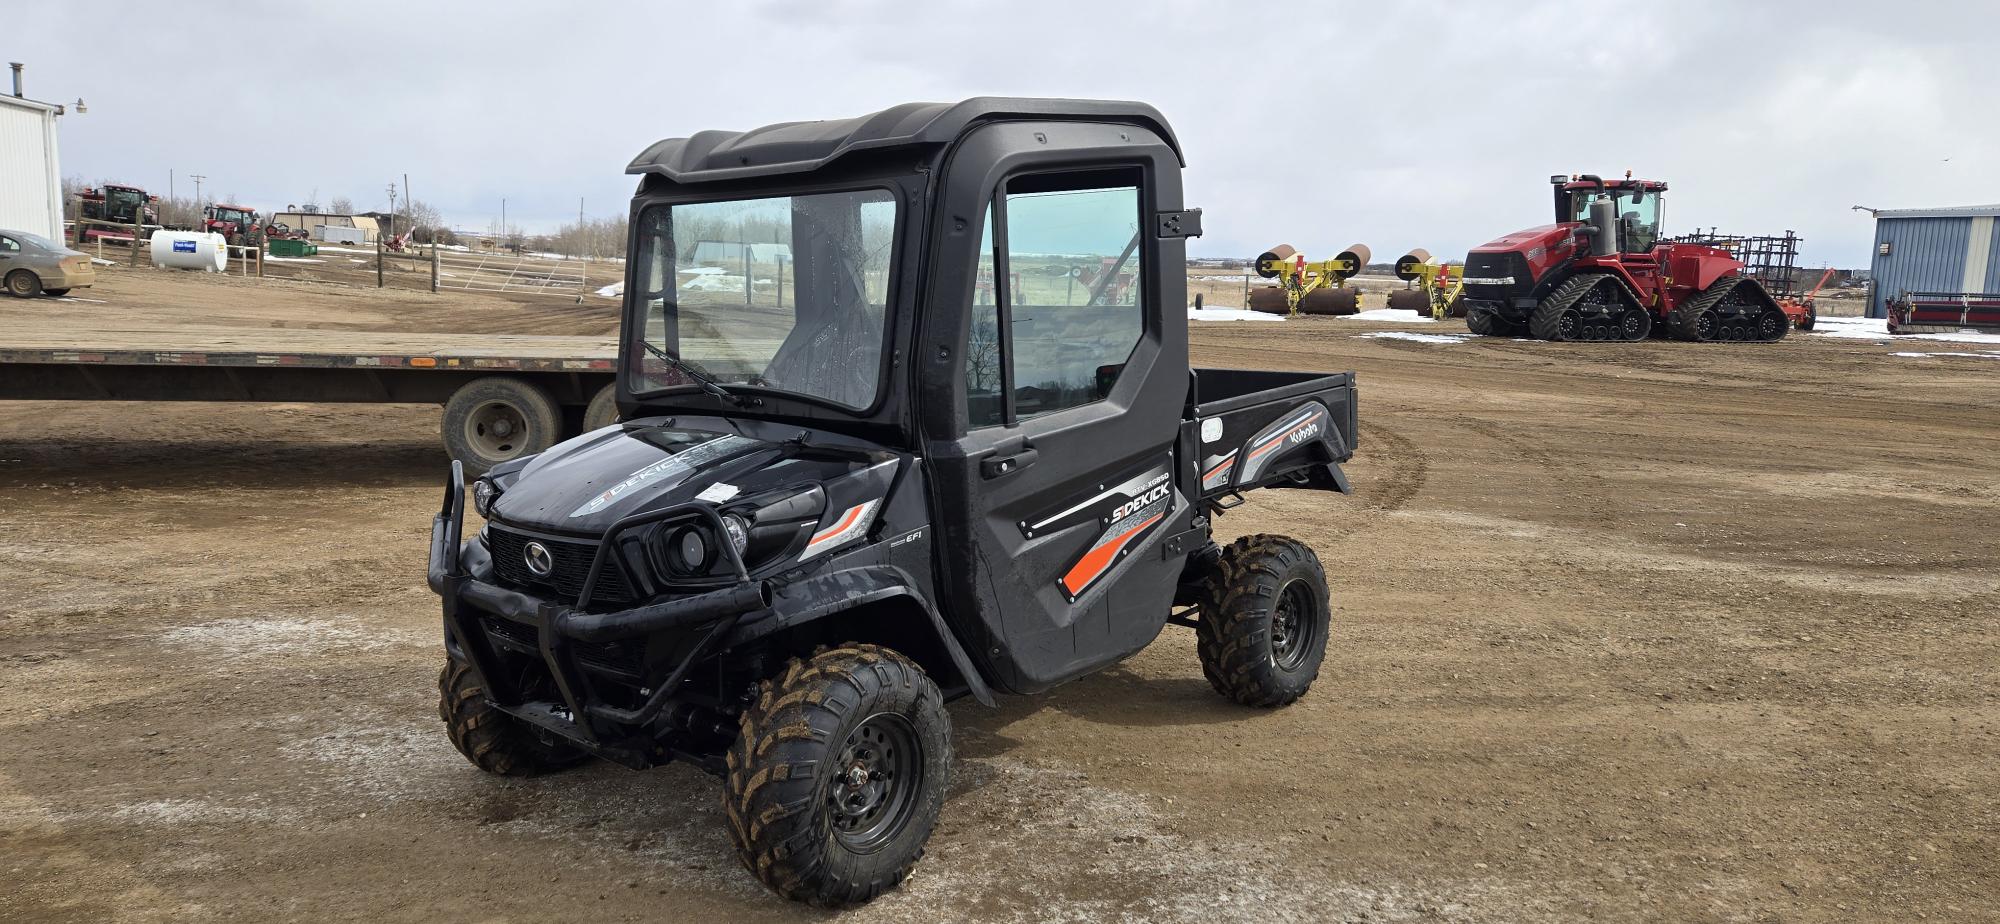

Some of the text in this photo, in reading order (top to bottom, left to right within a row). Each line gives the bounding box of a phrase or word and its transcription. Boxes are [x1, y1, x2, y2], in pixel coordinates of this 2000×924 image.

[1289, 422, 1318, 443] Kubota
[1110, 481, 1170, 524] SIDEKICK
[906, 530, 922, 542] EFI
